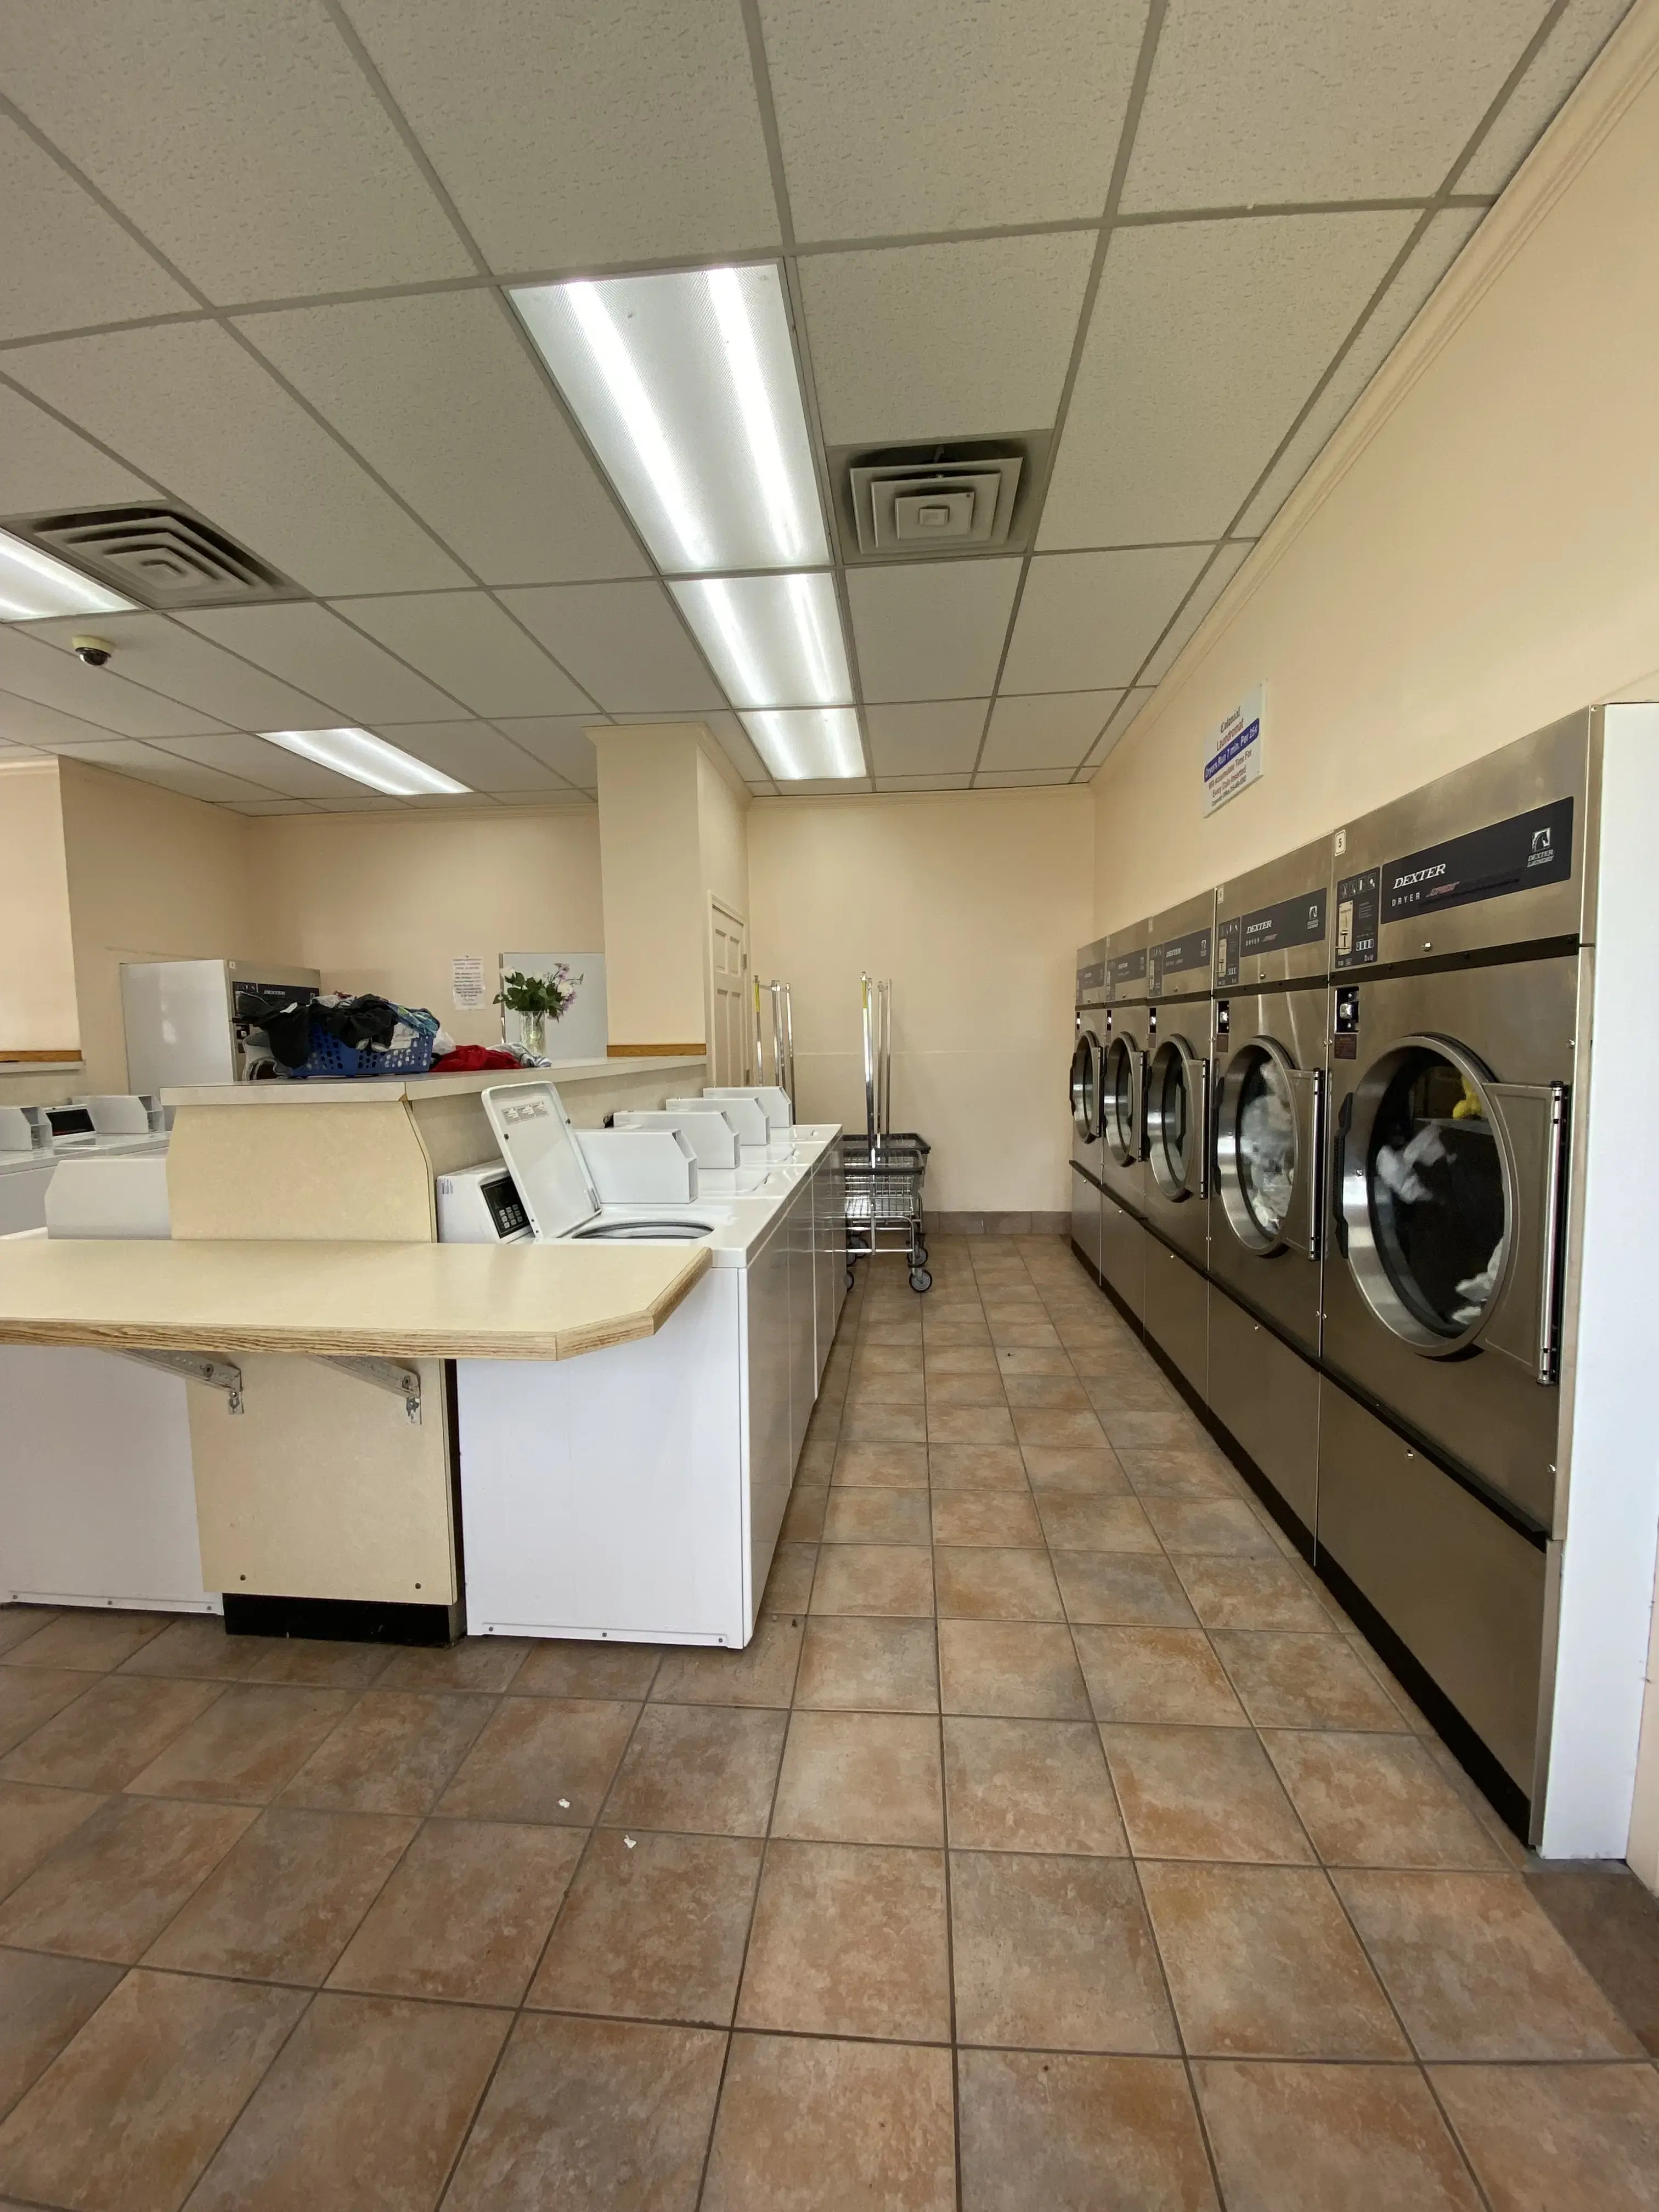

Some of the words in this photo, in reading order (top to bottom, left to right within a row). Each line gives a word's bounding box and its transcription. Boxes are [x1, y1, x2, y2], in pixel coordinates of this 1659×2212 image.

[1220, 706, 1240, 733] Colonial
[1205, 761, 1217, 778] Dryers
[1240, 733, 1249, 747] Per
[1392, 863, 1446, 889] DEXTER
[1391, 892, 1420, 907] DRYER
[1246, 920, 1272, 934] DEXTER
